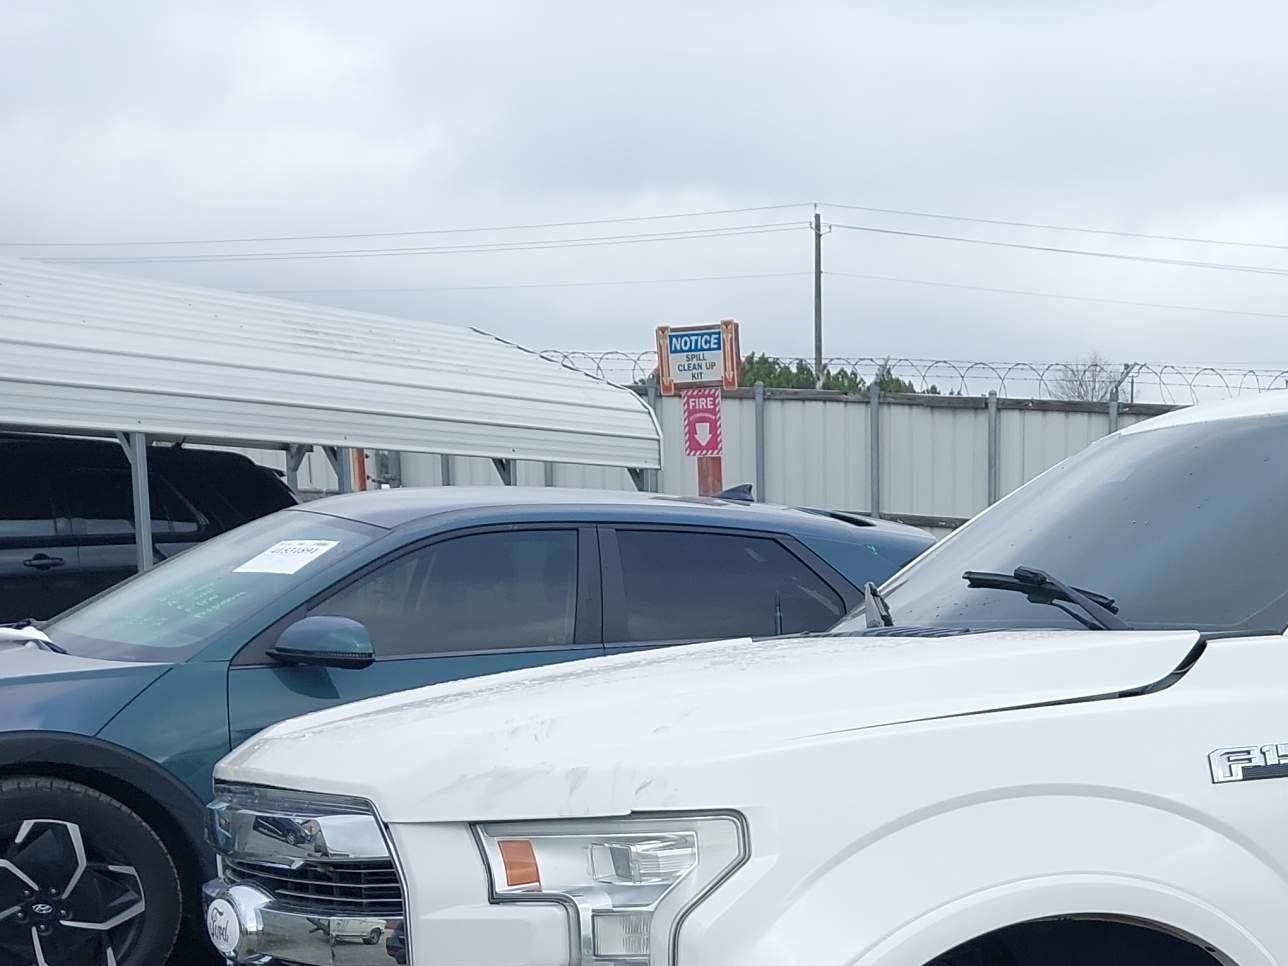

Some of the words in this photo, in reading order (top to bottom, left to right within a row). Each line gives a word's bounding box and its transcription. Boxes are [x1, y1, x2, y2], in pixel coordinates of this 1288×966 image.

[671, 334, 719, 351] NOTICE
[686, 353, 706, 362] SPILL
[677, 363, 702, 372] CLEAN
[705, 362, 716, 370] UP
[691, 372, 703, 380] KIT
[690, 397, 714, 409] FIRE
[209, 906, 229, 942] Ford
